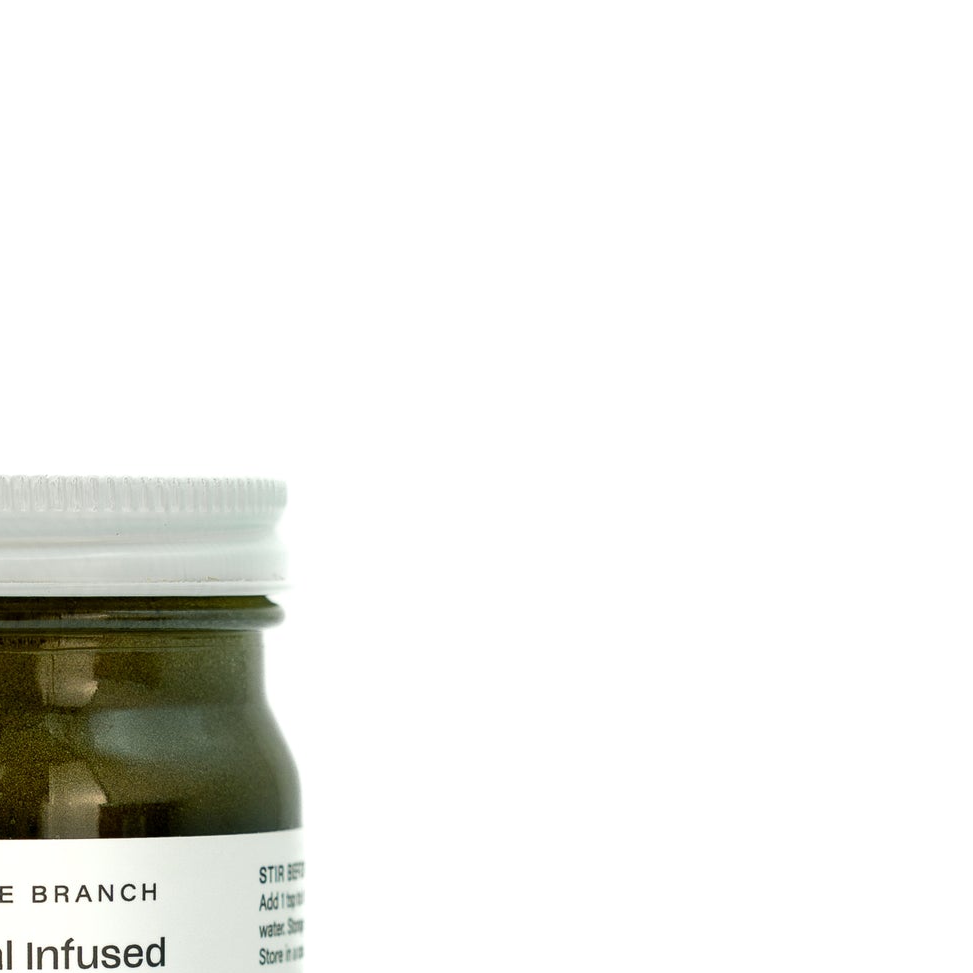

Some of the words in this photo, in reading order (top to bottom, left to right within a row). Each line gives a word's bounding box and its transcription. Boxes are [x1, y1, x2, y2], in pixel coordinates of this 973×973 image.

[258, 865, 284, 884] STIR
[32, 882, 158, 904] BRANCH
[258, 892, 279, 911] Add
[27, 936, 166, 970] Infused
[258, 947, 283, 966] Store
